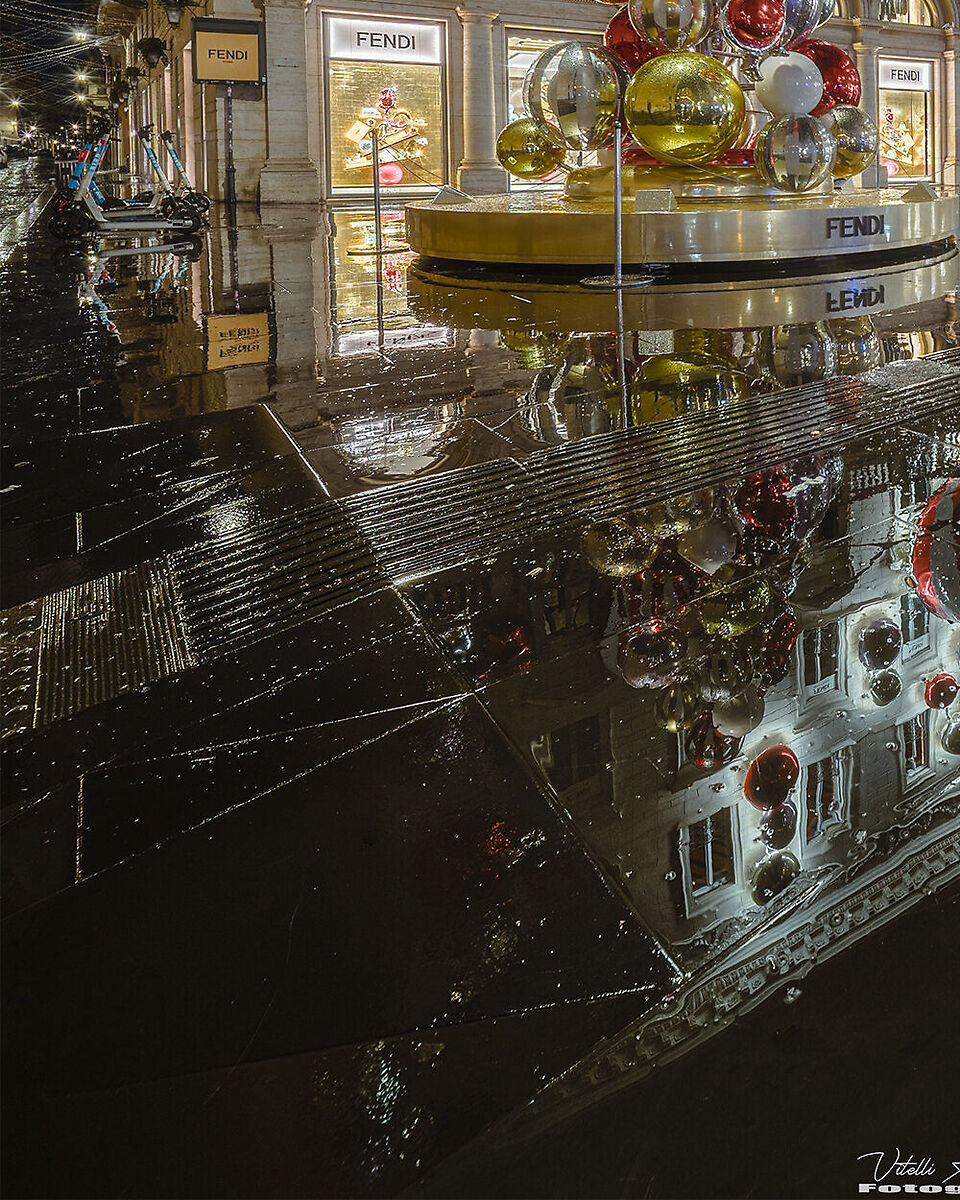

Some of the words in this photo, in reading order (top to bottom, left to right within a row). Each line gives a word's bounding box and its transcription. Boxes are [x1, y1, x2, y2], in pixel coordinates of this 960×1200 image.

[356, 31, 416, 50] FENDI
[208, 49, 248, 60] FENDI
[890, 69, 920, 82] FENDI
[826, 214, 885, 239] FENDI
